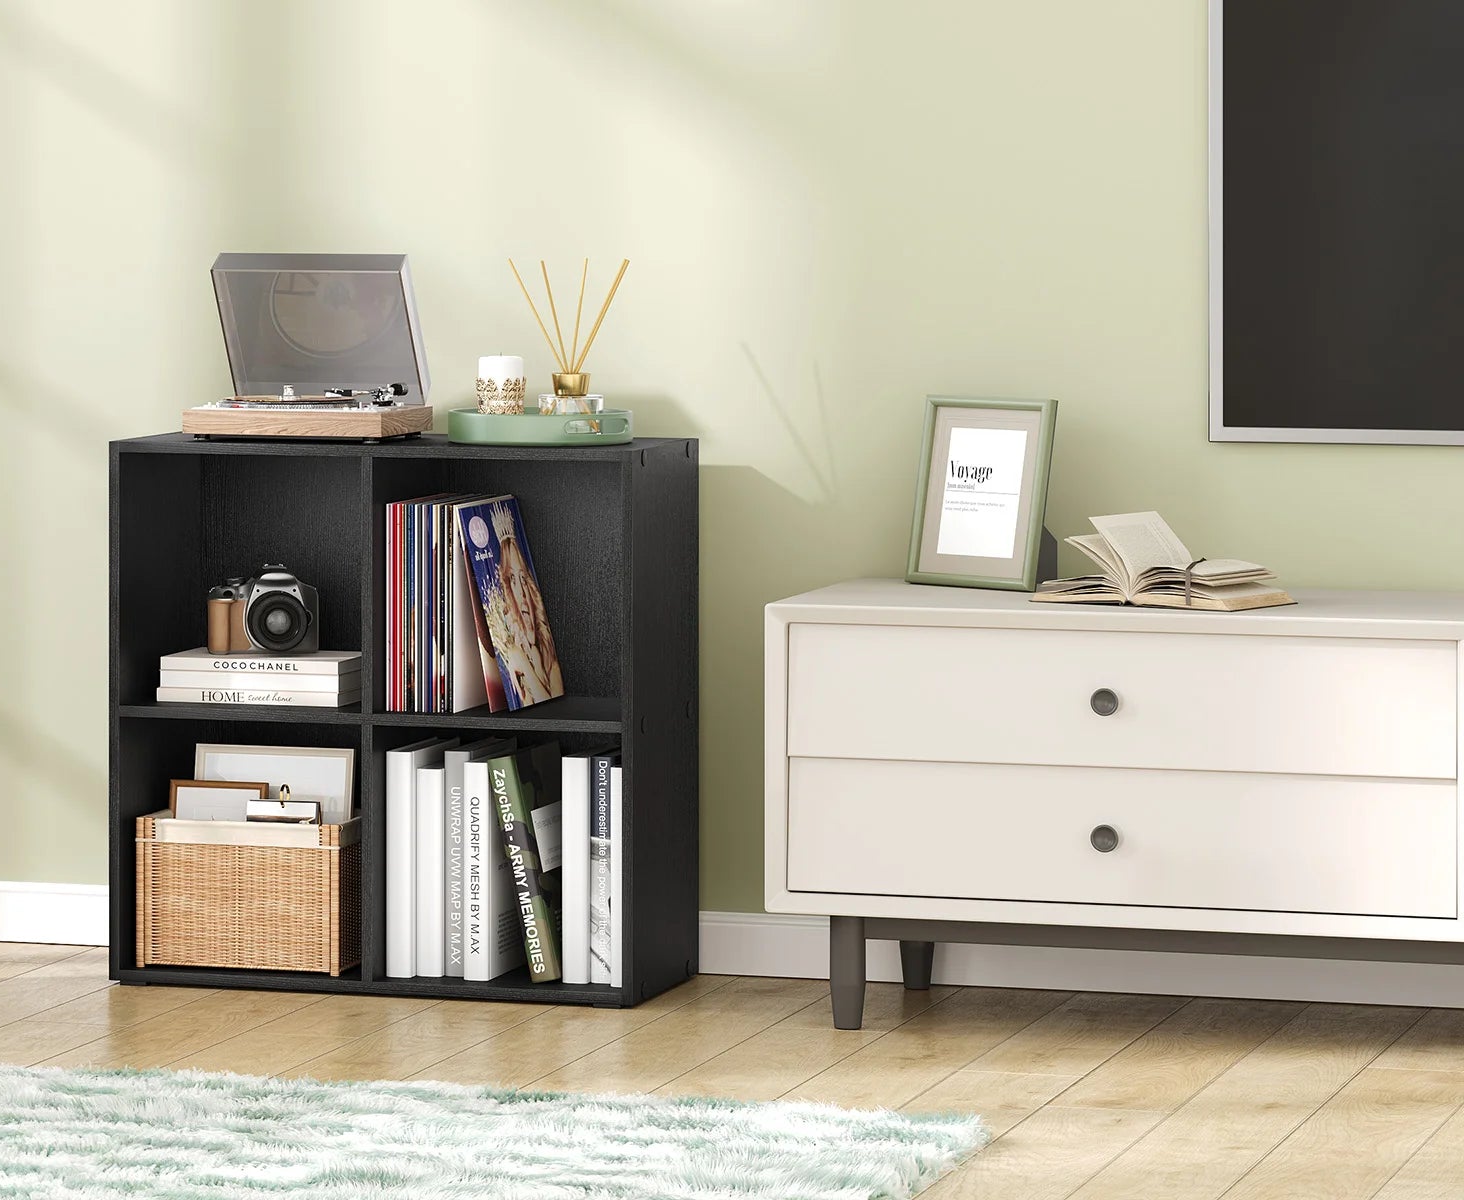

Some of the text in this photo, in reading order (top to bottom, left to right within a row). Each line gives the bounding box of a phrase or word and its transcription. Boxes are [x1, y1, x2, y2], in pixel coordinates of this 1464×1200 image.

[951, 460, 993, 484] Voyage
[201, 691, 246, 703] HOME
[598, 760, 608, 786] Don't
[493, 768, 515, 832] ZaychSa
[598, 788, 608, 857] underestimate
[450, 786, 461, 965] UNWRAP UVW MAP BY M.AX
[469, 796, 480, 955] QUADRIFY MESH BY M.AX
[508, 844, 529, 888] ARMY
[599, 858, 608, 874] the
[597, 876, 606, 905] power
[518, 891, 546, 975] MEMORIES
